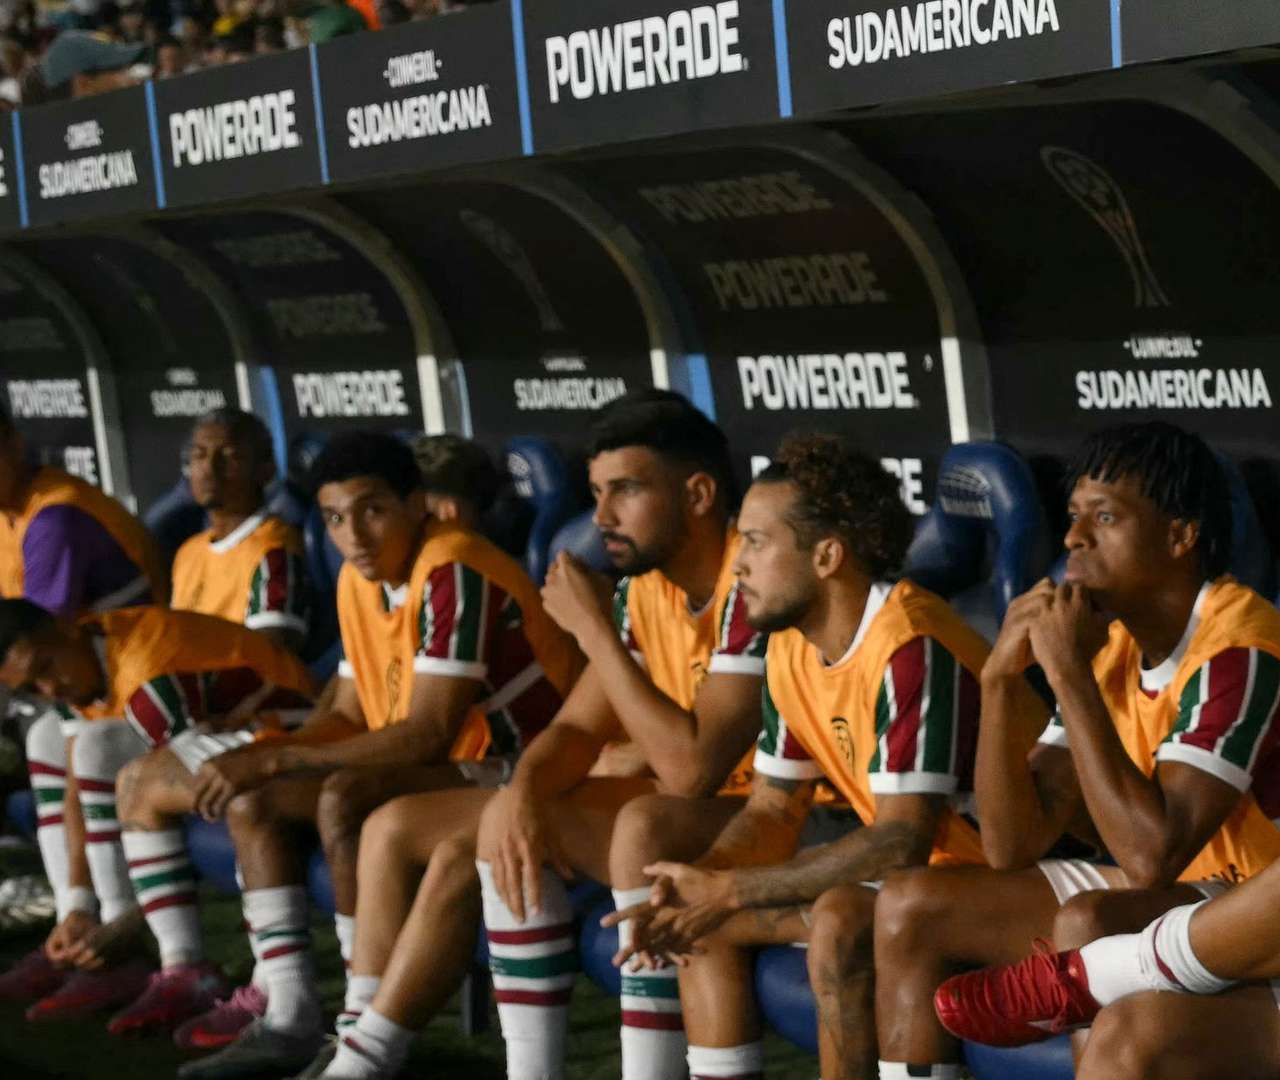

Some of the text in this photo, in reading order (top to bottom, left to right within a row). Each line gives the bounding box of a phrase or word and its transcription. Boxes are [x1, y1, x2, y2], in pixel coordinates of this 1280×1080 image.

[546, 0, 742, 103] POWERADE
[828, 0, 1059, 69] SUDAMERICANA
[169, 89, 298, 167] POWERADE
[737, 351, 916, 410] POWERADE
[1075, 368, 1272, 410] SUDAMERICANA
